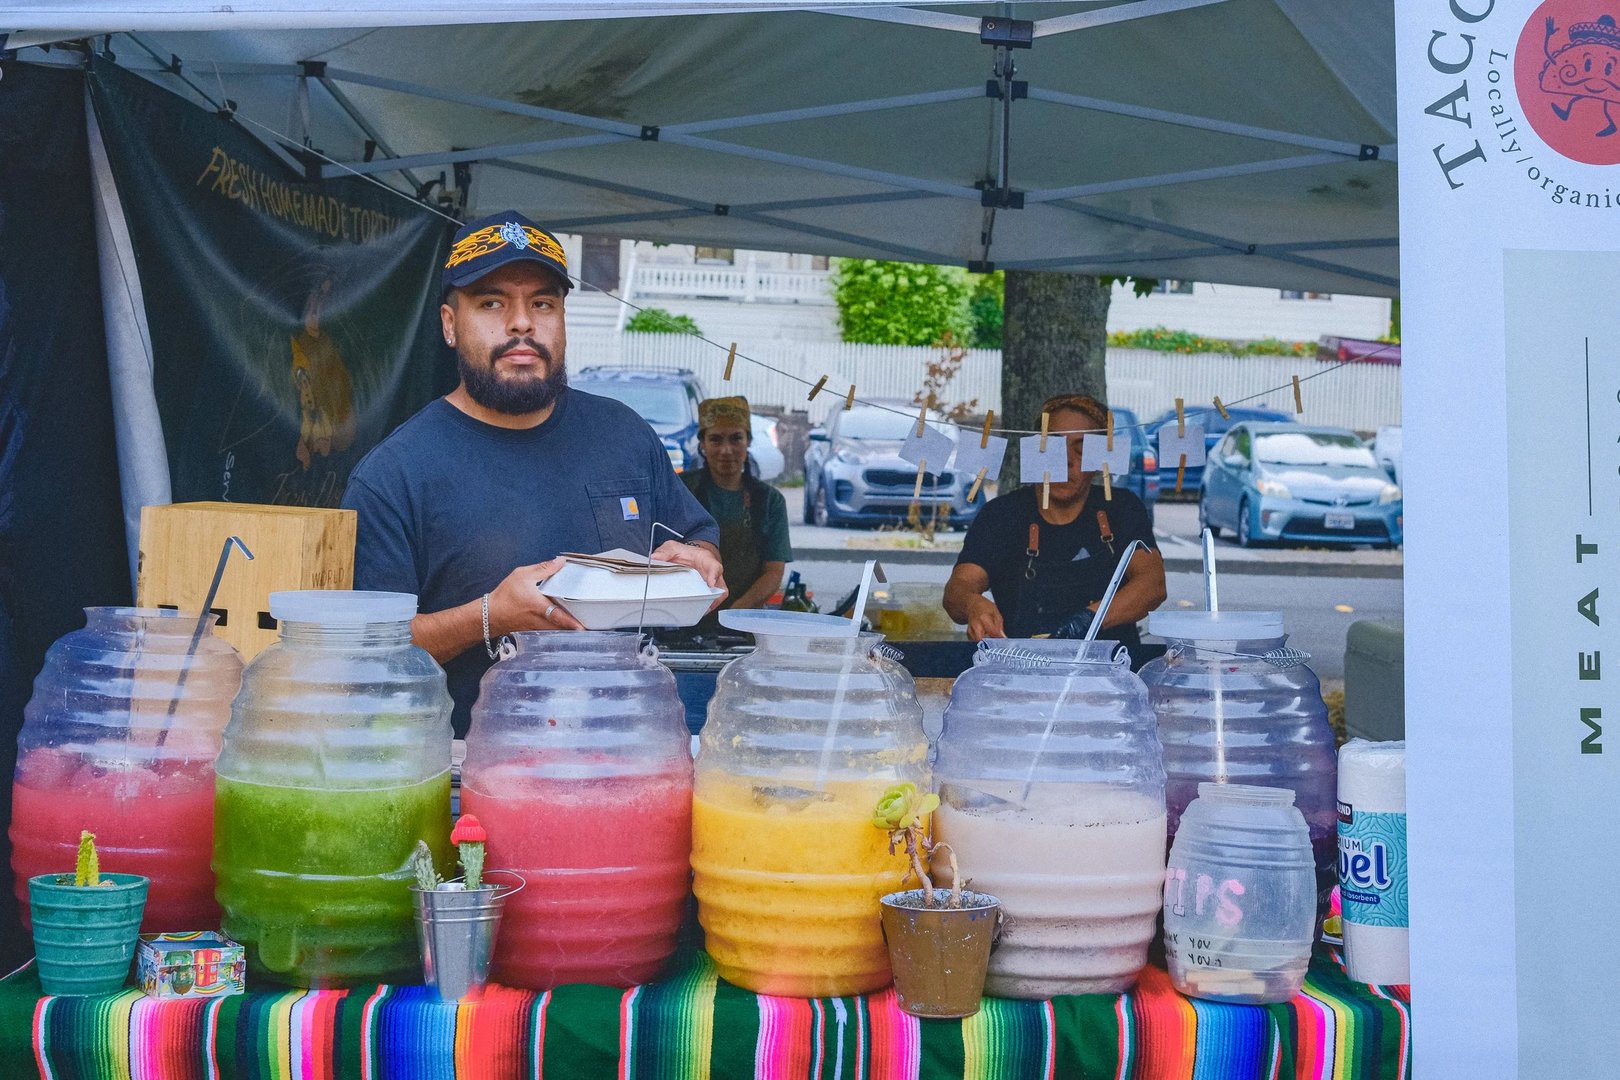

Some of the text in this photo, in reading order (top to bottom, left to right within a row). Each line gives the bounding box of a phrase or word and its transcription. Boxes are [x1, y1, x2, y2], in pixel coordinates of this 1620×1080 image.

[196, 146, 262, 211] FRESH
[260, 172, 349, 240] HOMEMADE
[311, 566, 344, 588] WORLD
[1576, 534, 1603, 754] MEAT
